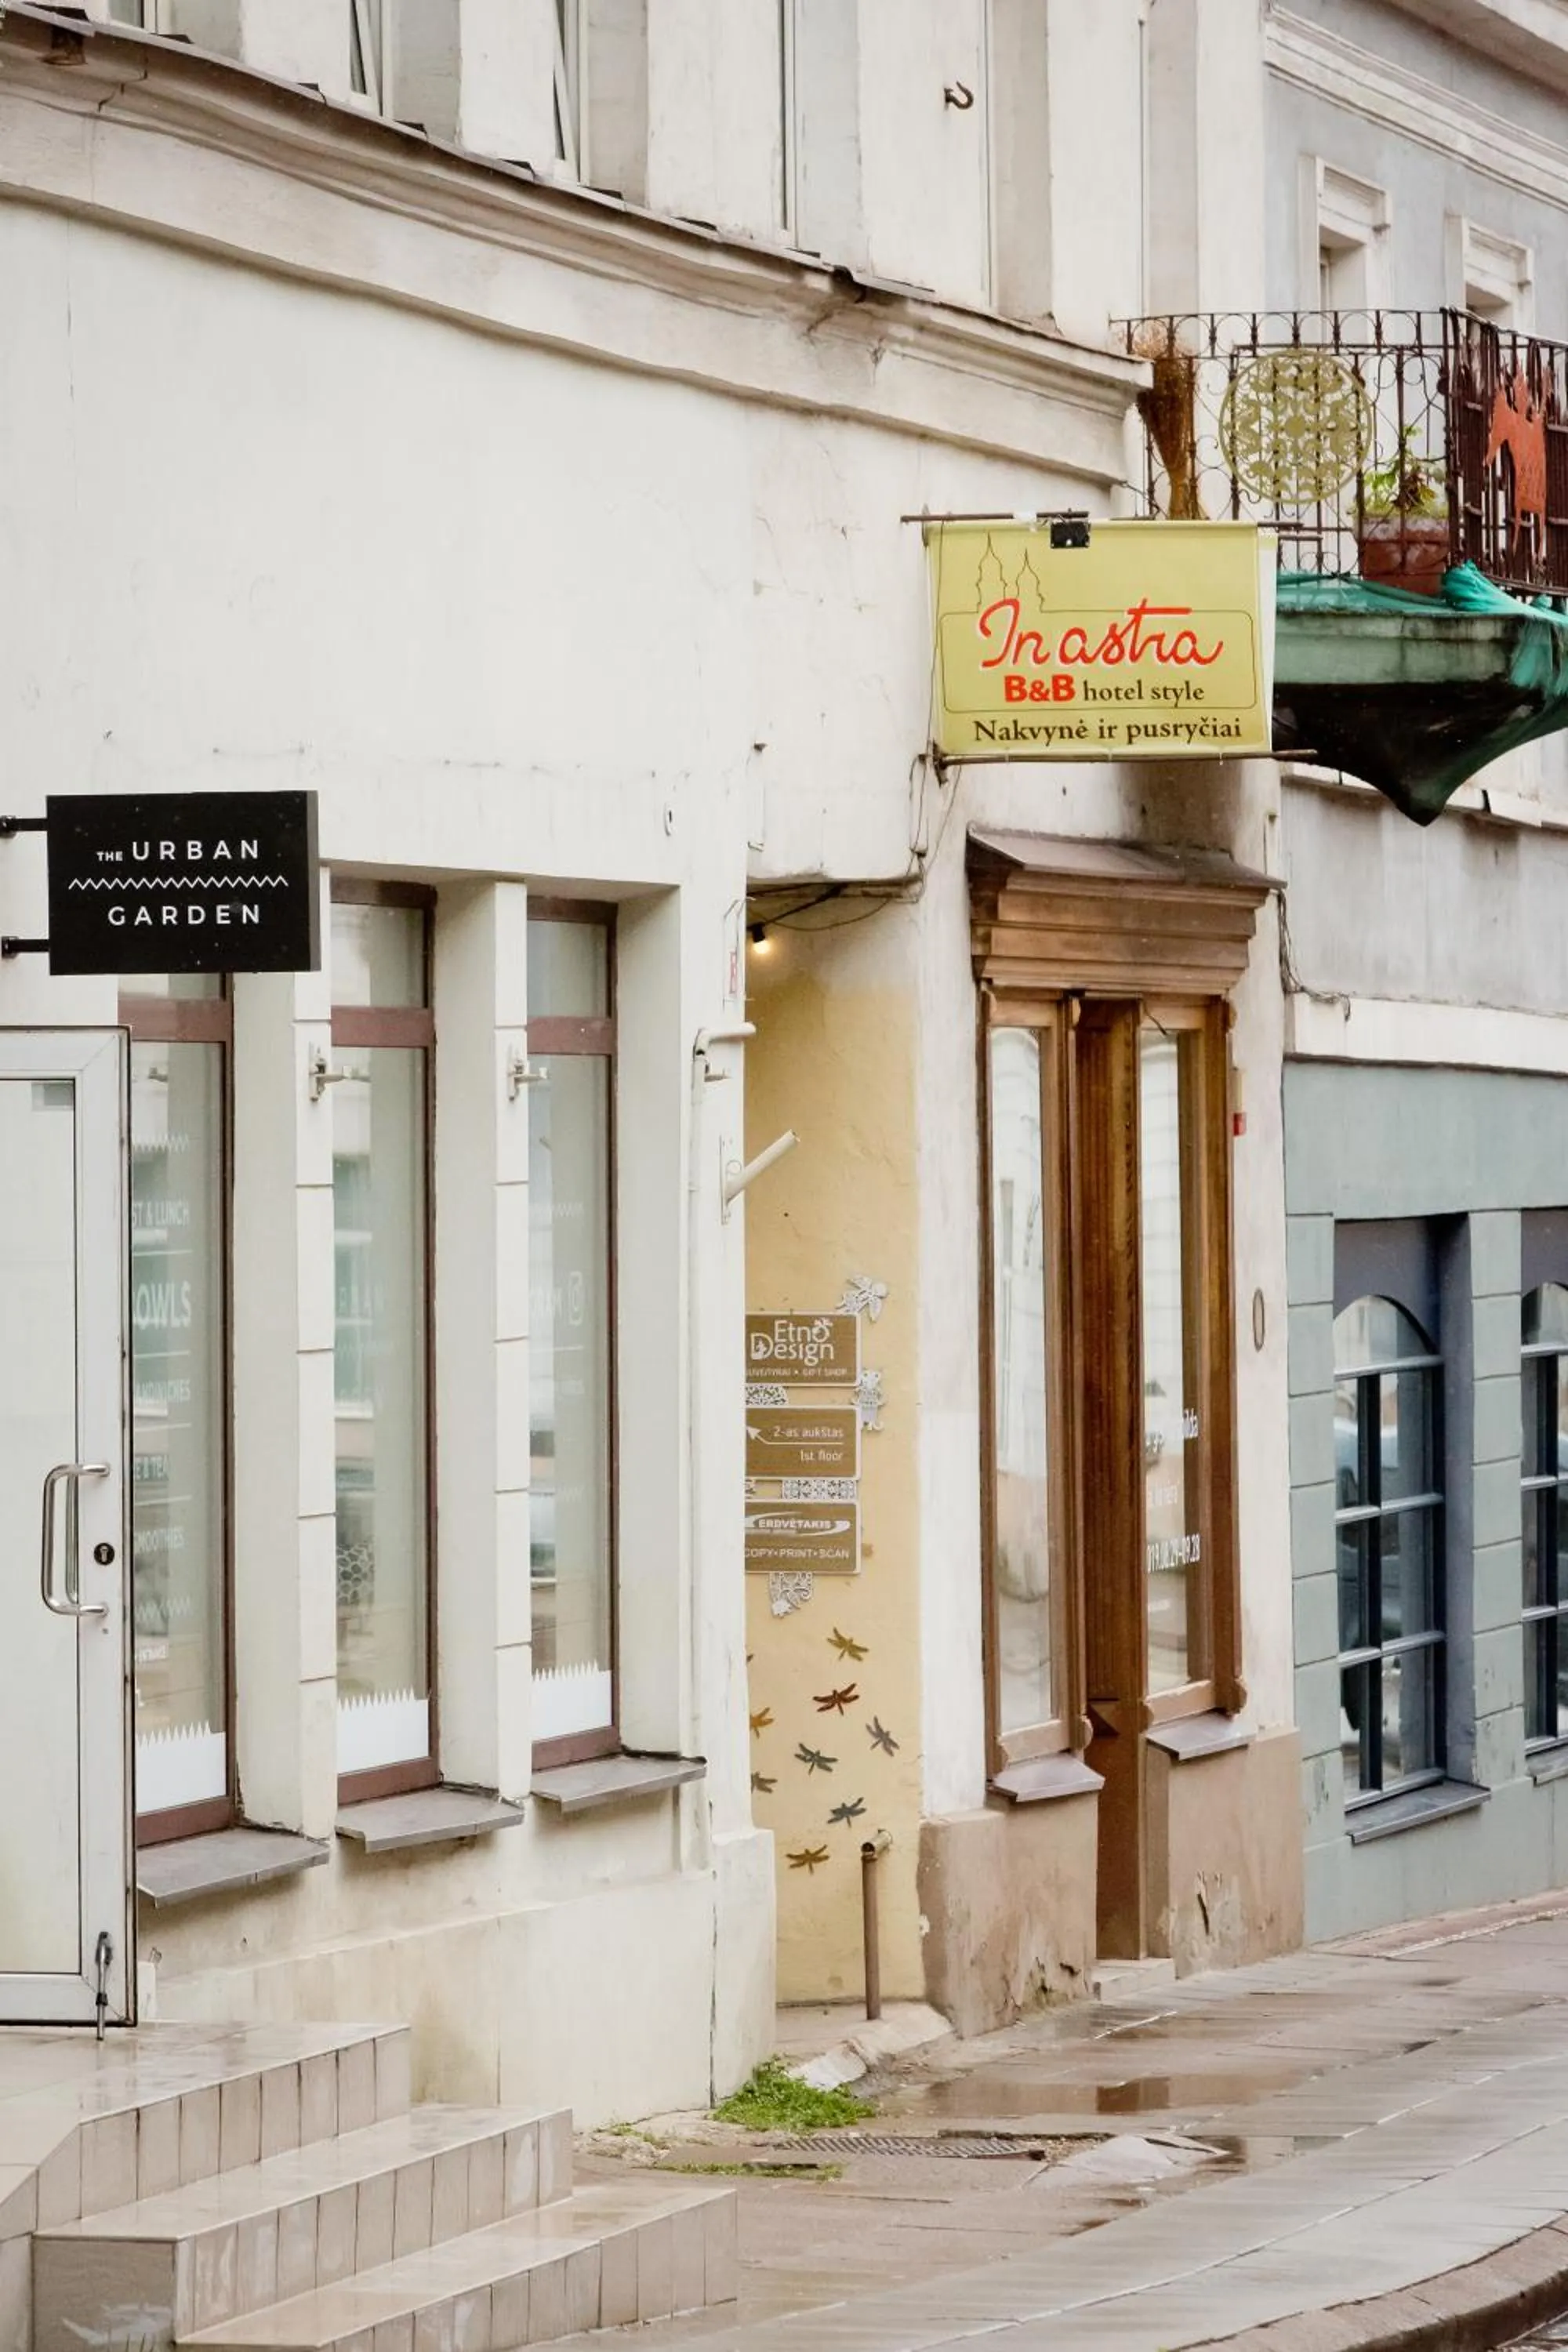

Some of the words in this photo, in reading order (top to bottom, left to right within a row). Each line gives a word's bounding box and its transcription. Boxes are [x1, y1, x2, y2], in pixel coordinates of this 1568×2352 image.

[1004, 675, 1076, 702] B&B
[1083, 681, 1143, 701] hotel
[1151, 682, 1205, 707] style
[974, 720, 1088, 746] Nakvynė
[1098, 719, 1117, 739] ir
[1126, 718, 1241, 746] pusryčiai
[96, 851, 123, 862] THE
[132, 840, 259, 861] URBAN
[108, 905, 260, 926] GARDEN
[133, 1281, 191, 1329] OWLS
[750, 1332, 834, 1367] Design
